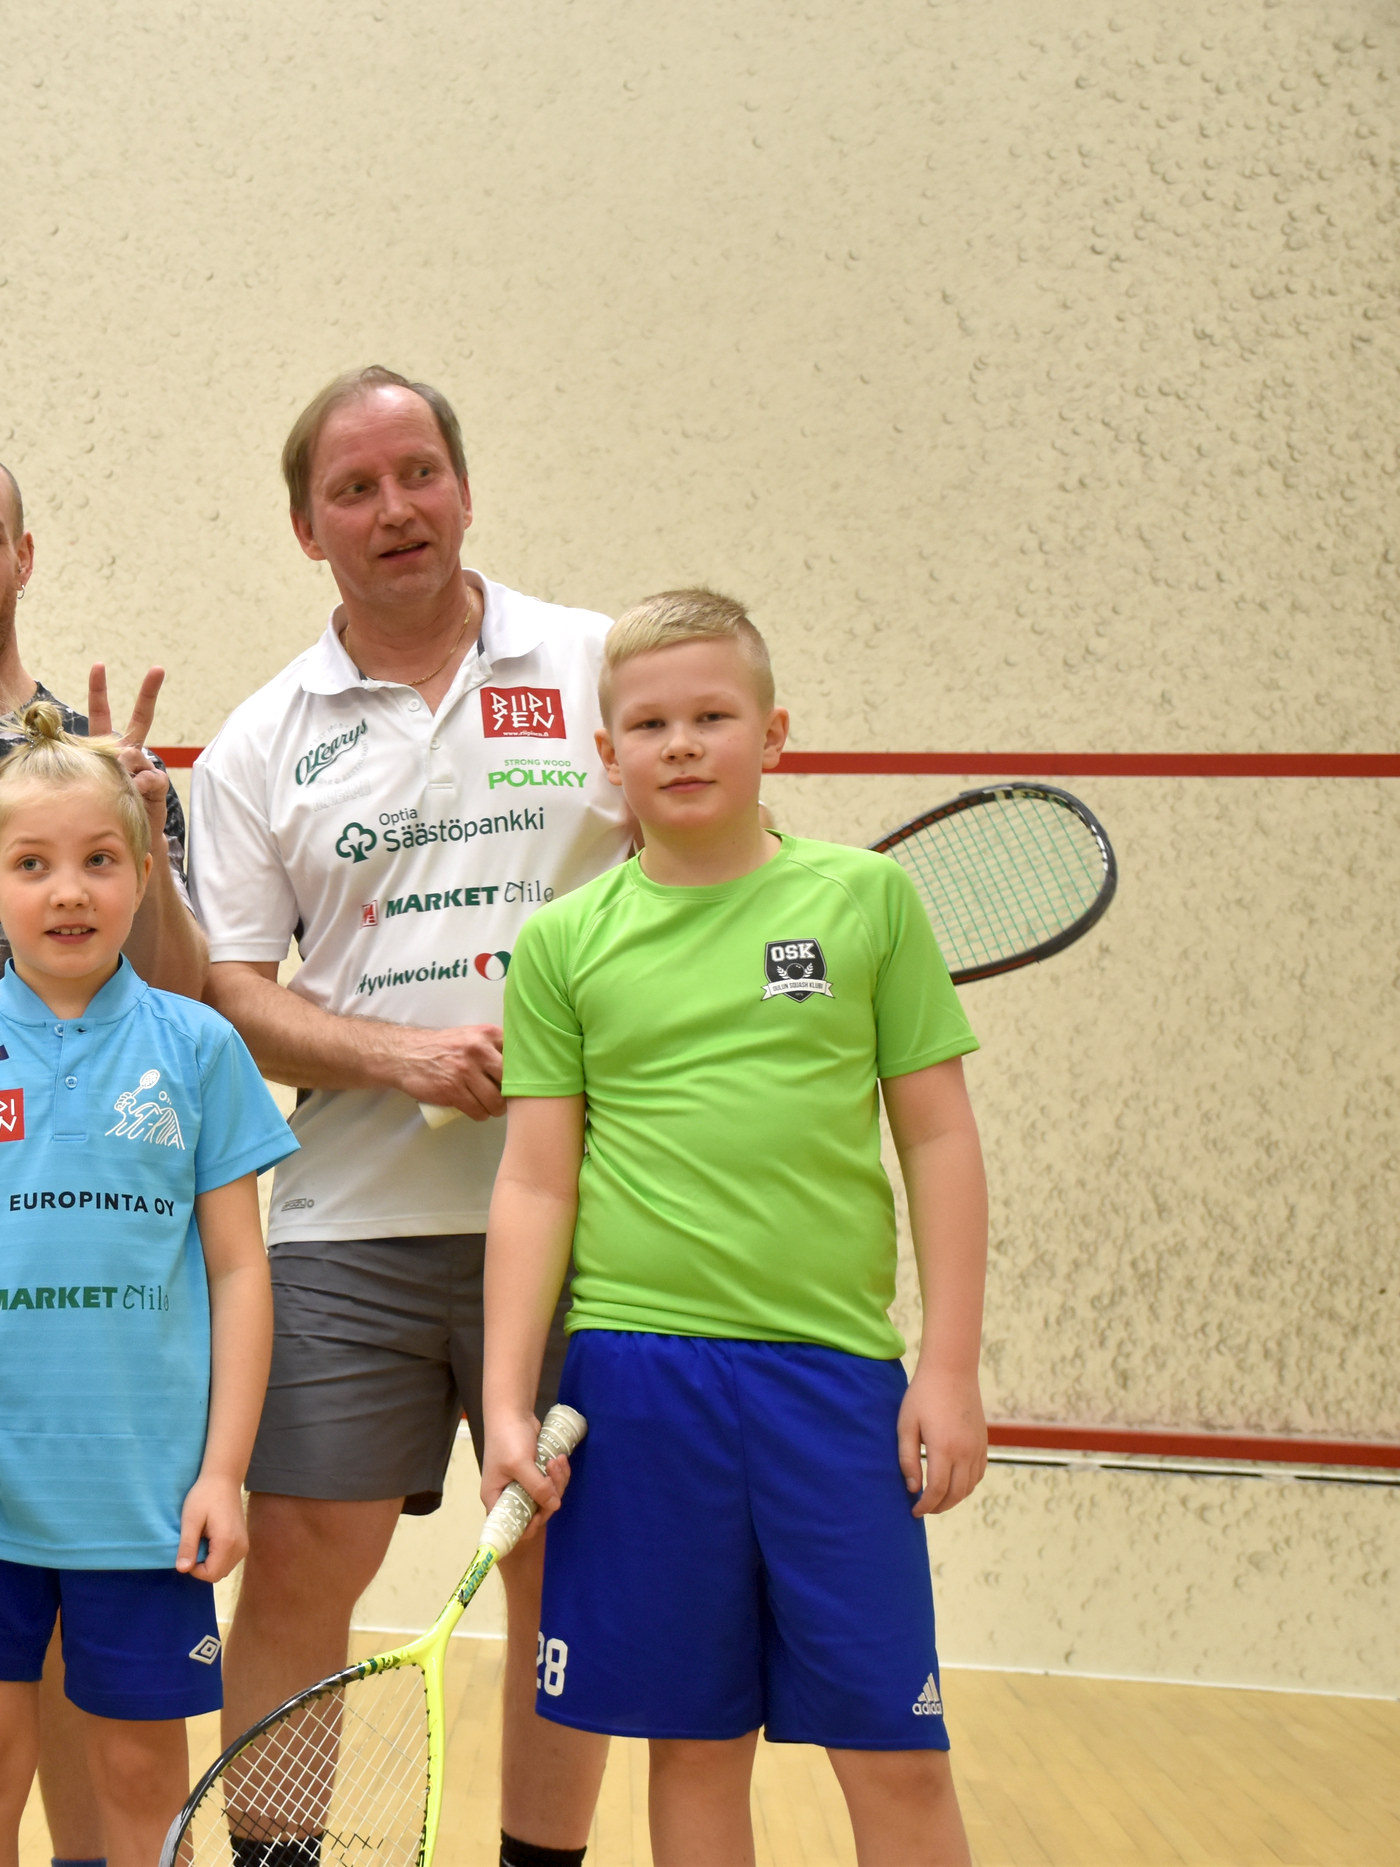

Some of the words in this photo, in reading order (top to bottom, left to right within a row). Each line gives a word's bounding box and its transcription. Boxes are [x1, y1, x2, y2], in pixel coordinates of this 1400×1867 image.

[504, 759, 541, 767] STRONG
[378, 808, 418, 827] Optia
[382, 806, 546, 853] Säästöpankki
[385, 886, 500, 919] MARKET
[770, 942, 816, 962] OSK
[9, 1190, 149, 1213] EUROPINTA
[154, 1197, 175, 1217] OY
[911, 1701, 943, 1716] adida
